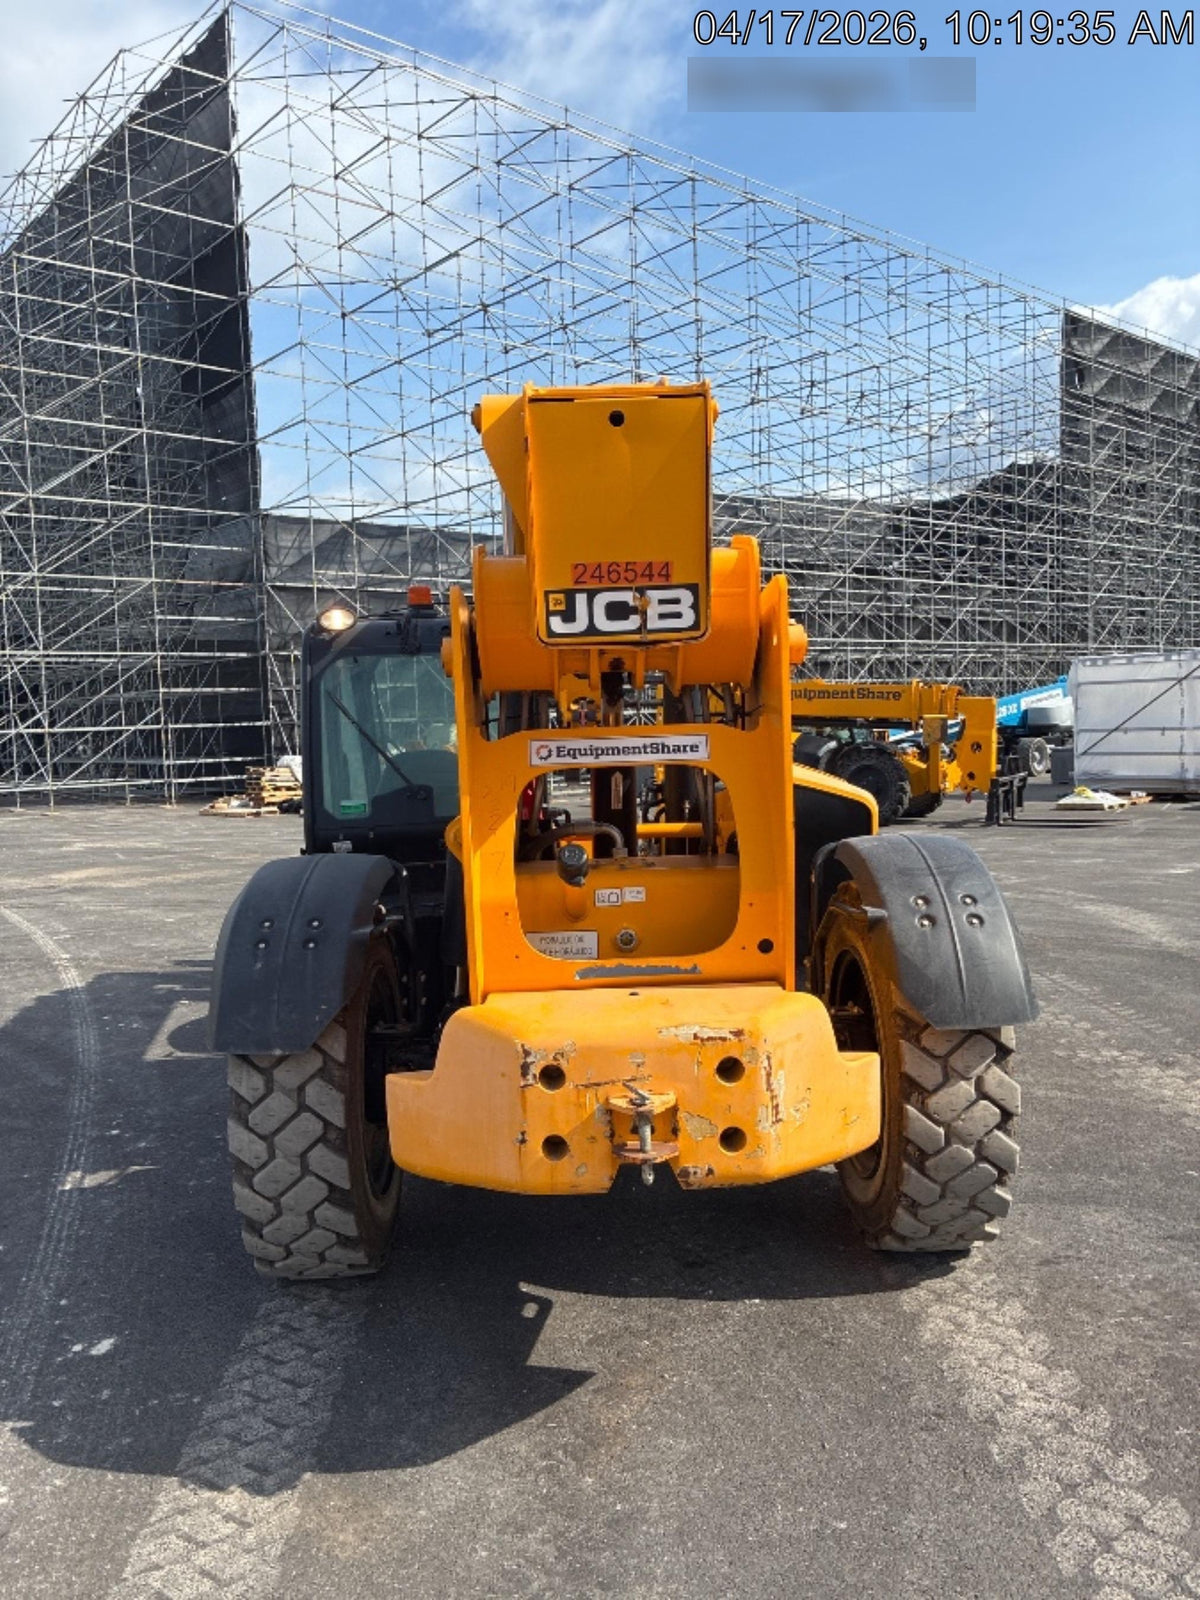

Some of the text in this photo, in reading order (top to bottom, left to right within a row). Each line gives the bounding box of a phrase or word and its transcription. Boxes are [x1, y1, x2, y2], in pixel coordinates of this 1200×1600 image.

[573, 561, 671, 584] 246544
[549, 588, 696, 634] JCB
[555, 742, 700, 760] EquipmentShare
